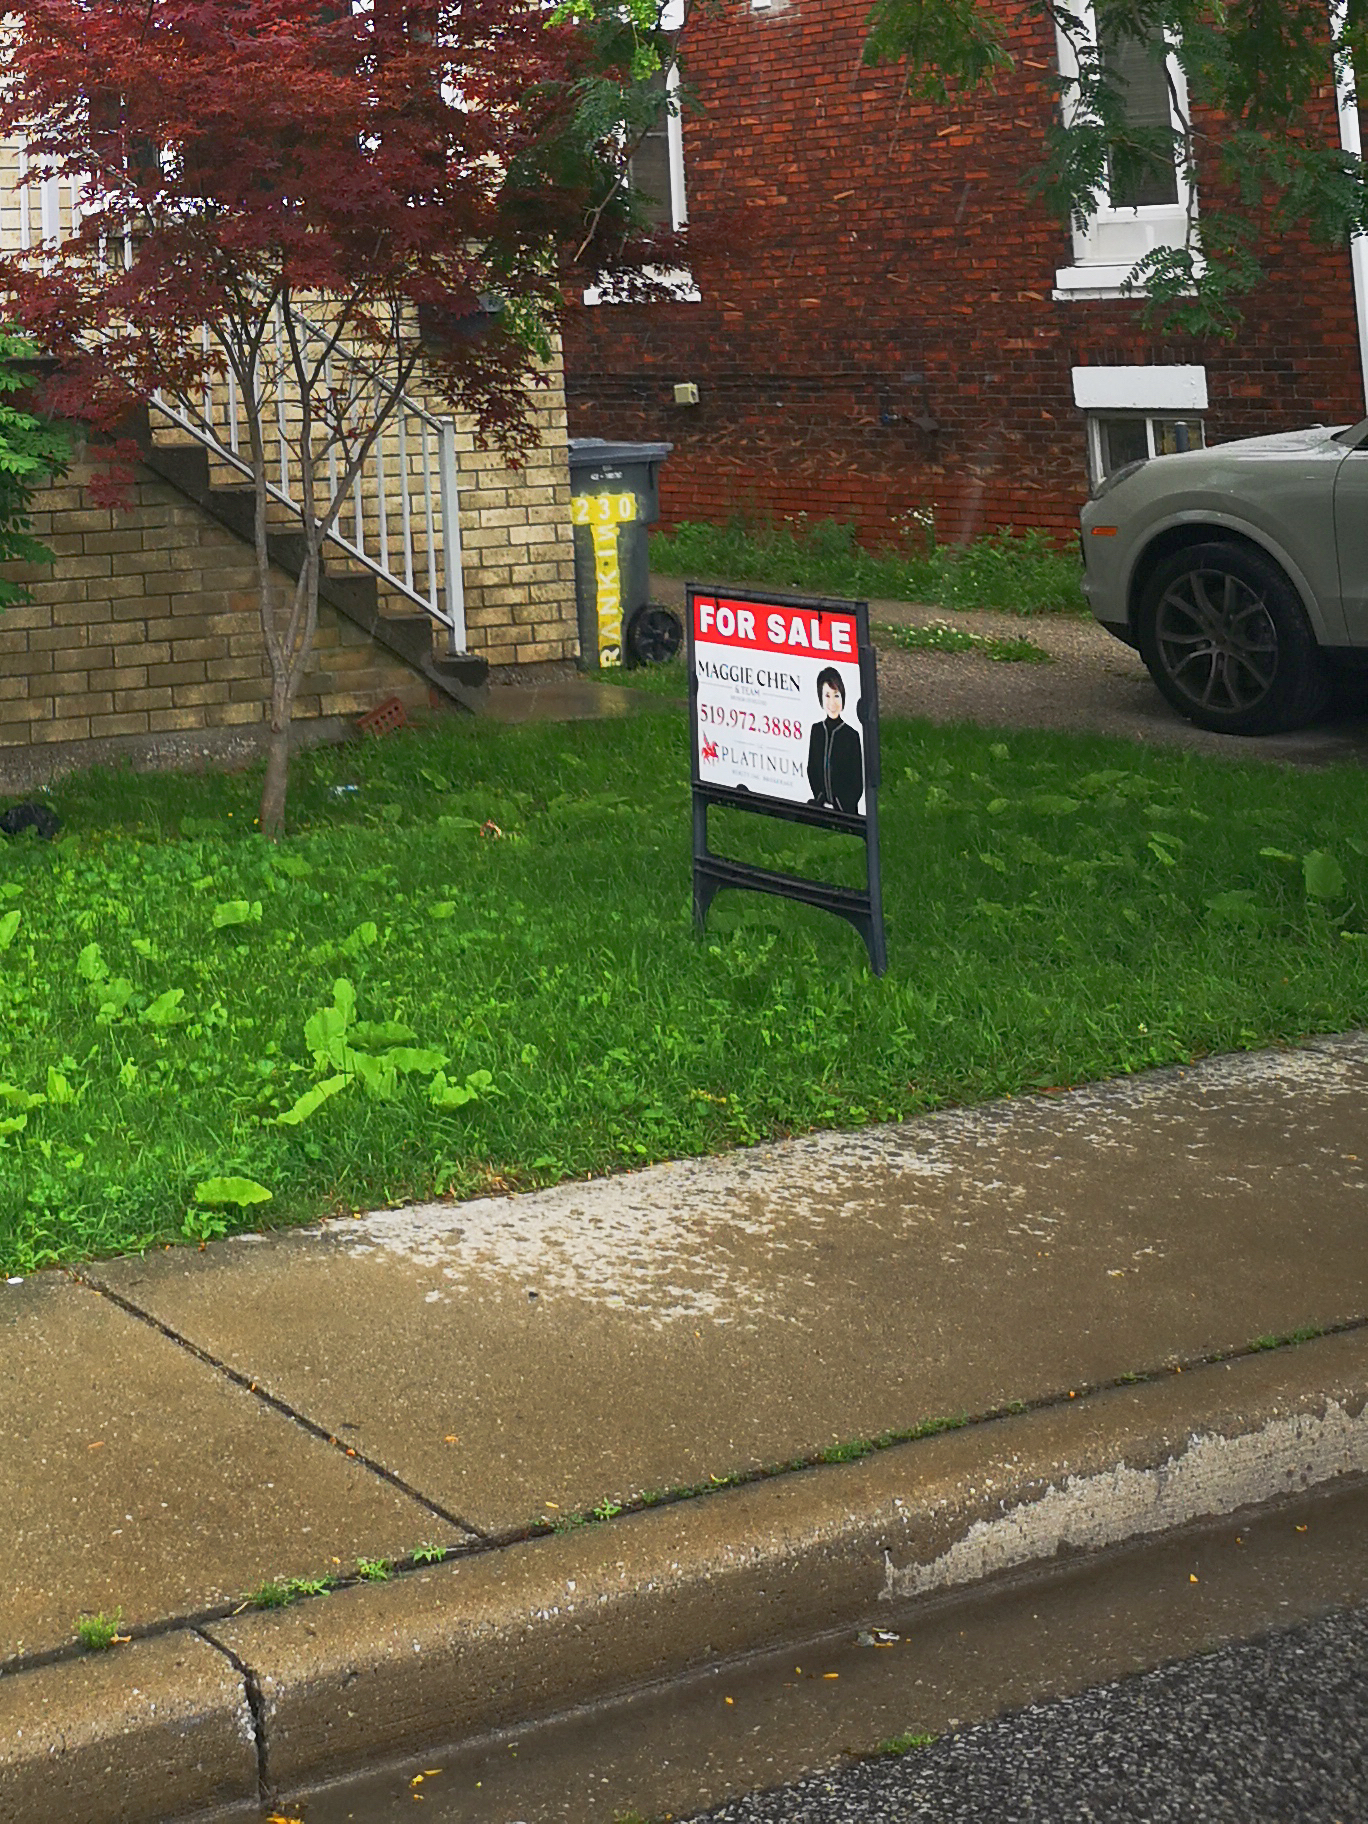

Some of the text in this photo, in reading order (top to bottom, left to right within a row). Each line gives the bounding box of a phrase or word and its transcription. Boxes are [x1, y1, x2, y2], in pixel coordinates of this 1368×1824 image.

[576, 497, 631, 521] 230
[699, 604, 852, 654] FOR SALE
[697, 659, 801, 693] MAGGIE CHEN
[700, 703, 803, 741] 519.972.3888
[721, 745, 805, 778] PLATINUM
